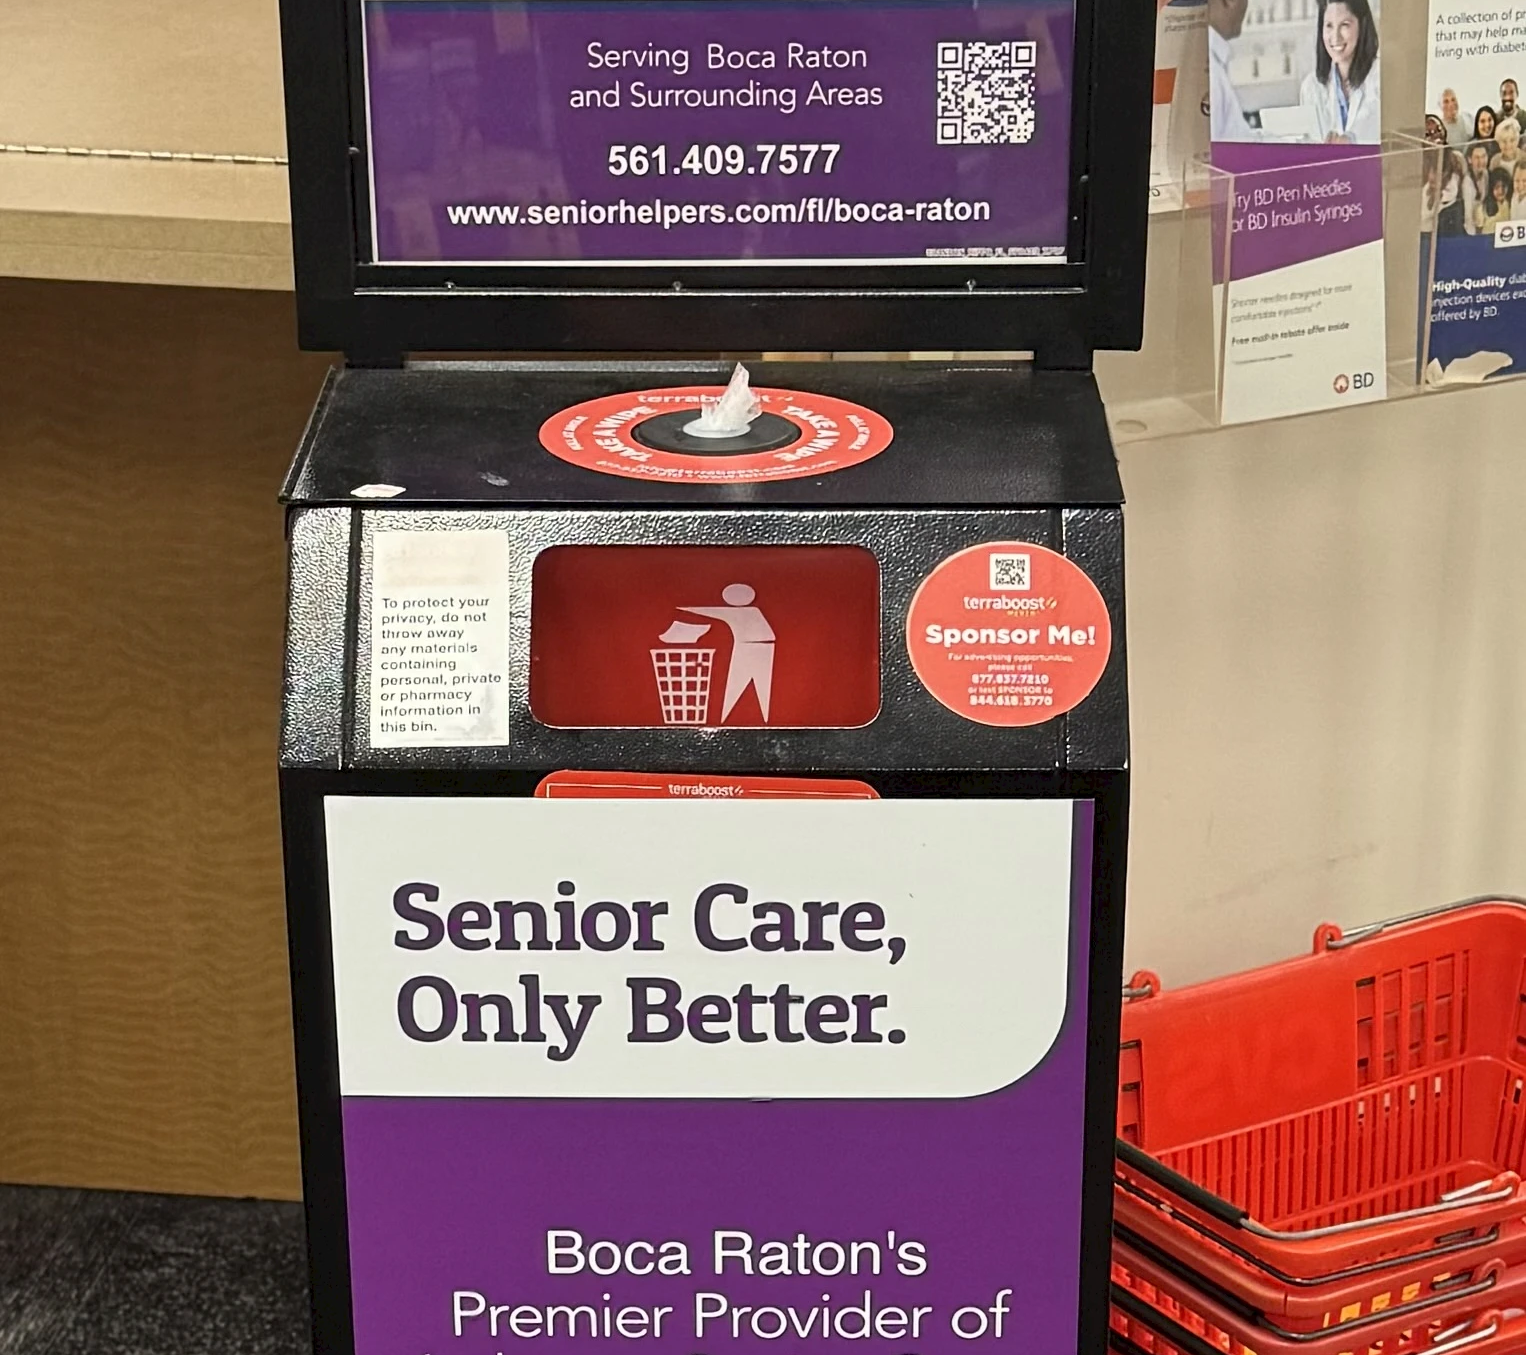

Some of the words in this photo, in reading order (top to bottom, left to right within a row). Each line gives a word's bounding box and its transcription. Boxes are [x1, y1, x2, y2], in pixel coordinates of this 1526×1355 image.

[1436, 14, 1445, 25] A
[1448, 12, 1498, 25] collection
[1501, 8, 1513, 21] of
[1435, 30, 1457, 42] that
[1460, 29, 1483, 42] may
[1486, 25, 1508, 38] help
[1466, 43, 1489, 55] with
[587, 42, 689, 75] Serving
[707, 44, 775, 70] Boca
[787, 44, 867, 70] Raton
[569, 84, 620, 108] and
[630, 82, 797, 115] Surrounding
[806, 83, 884, 107] Areas
[608, 143, 841, 176] 561.409.7577
[1254, 188, 1273, 206] BD
[1276, 186, 1299, 203] Pen
[1303, 179, 1352, 200] Needles
[447, 197, 991, 229] www.seniorhelpers.com/fl/boca-raton
[1248, 212, 1267, 230] BD
[1271, 207, 1311, 228] Insulin
[1314, 203, 1363, 225] Syringes
[1432, 276, 1507, 293] High-Quality
[1469, 309, 1480, 321] by
[1353, 372, 1374, 389] BD
[594, 406, 658, 428] WIPE
[781, 405, 837, 429] TAKE
[592, 429, 617, 437] A
[816, 429, 840, 438] A
[595, 438, 653, 462] TAKE
[773, 438, 839, 462] WIPE
[382, 598, 398, 609] To
[403, 598, 454, 611] protect
[459, 598, 490, 610] your
[963, 595, 1045, 610] terraboost
[381, 614, 436, 626] privacy,
[441, 612, 459, 623] do
[464, 612, 487, 622] not
[381, 629, 422, 639] throw
[427, 630, 464, 641] away
[925, 624, 1040, 648] Sponsor
[1048, 625, 1096, 645] Me!
[381, 646, 406, 656] any
[411, 644, 478, 653] materials
[381, 660, 457, 671] containing
[381, 675, 447, 687] personal,
[452, 674, 501, 685] private
[381, 692, 395, 701] or
[400, 690, 472, 702] pharmacy
[381, 706, 463, 717] information
[469, 705, 481, 715] in
[381, 722, 406, 732] this
[411, 722, 437, 732] bin.
[668, 782, 734, 796] terraboost
[392, 881, 668, 951] Senior
[694, 883, 906, 965] Care,
[398, 974, 603, 1062] Only
[626, 977, 906, 1044] Better.
[546, 1230, 691, 1275] Boca
[713, 1229, 928, 1276] Raton's
[452, 1290, 673, 1338] Premier
[695, 1289, 932, 1339] Provider
[951, 1288, 1013, 1339] of
